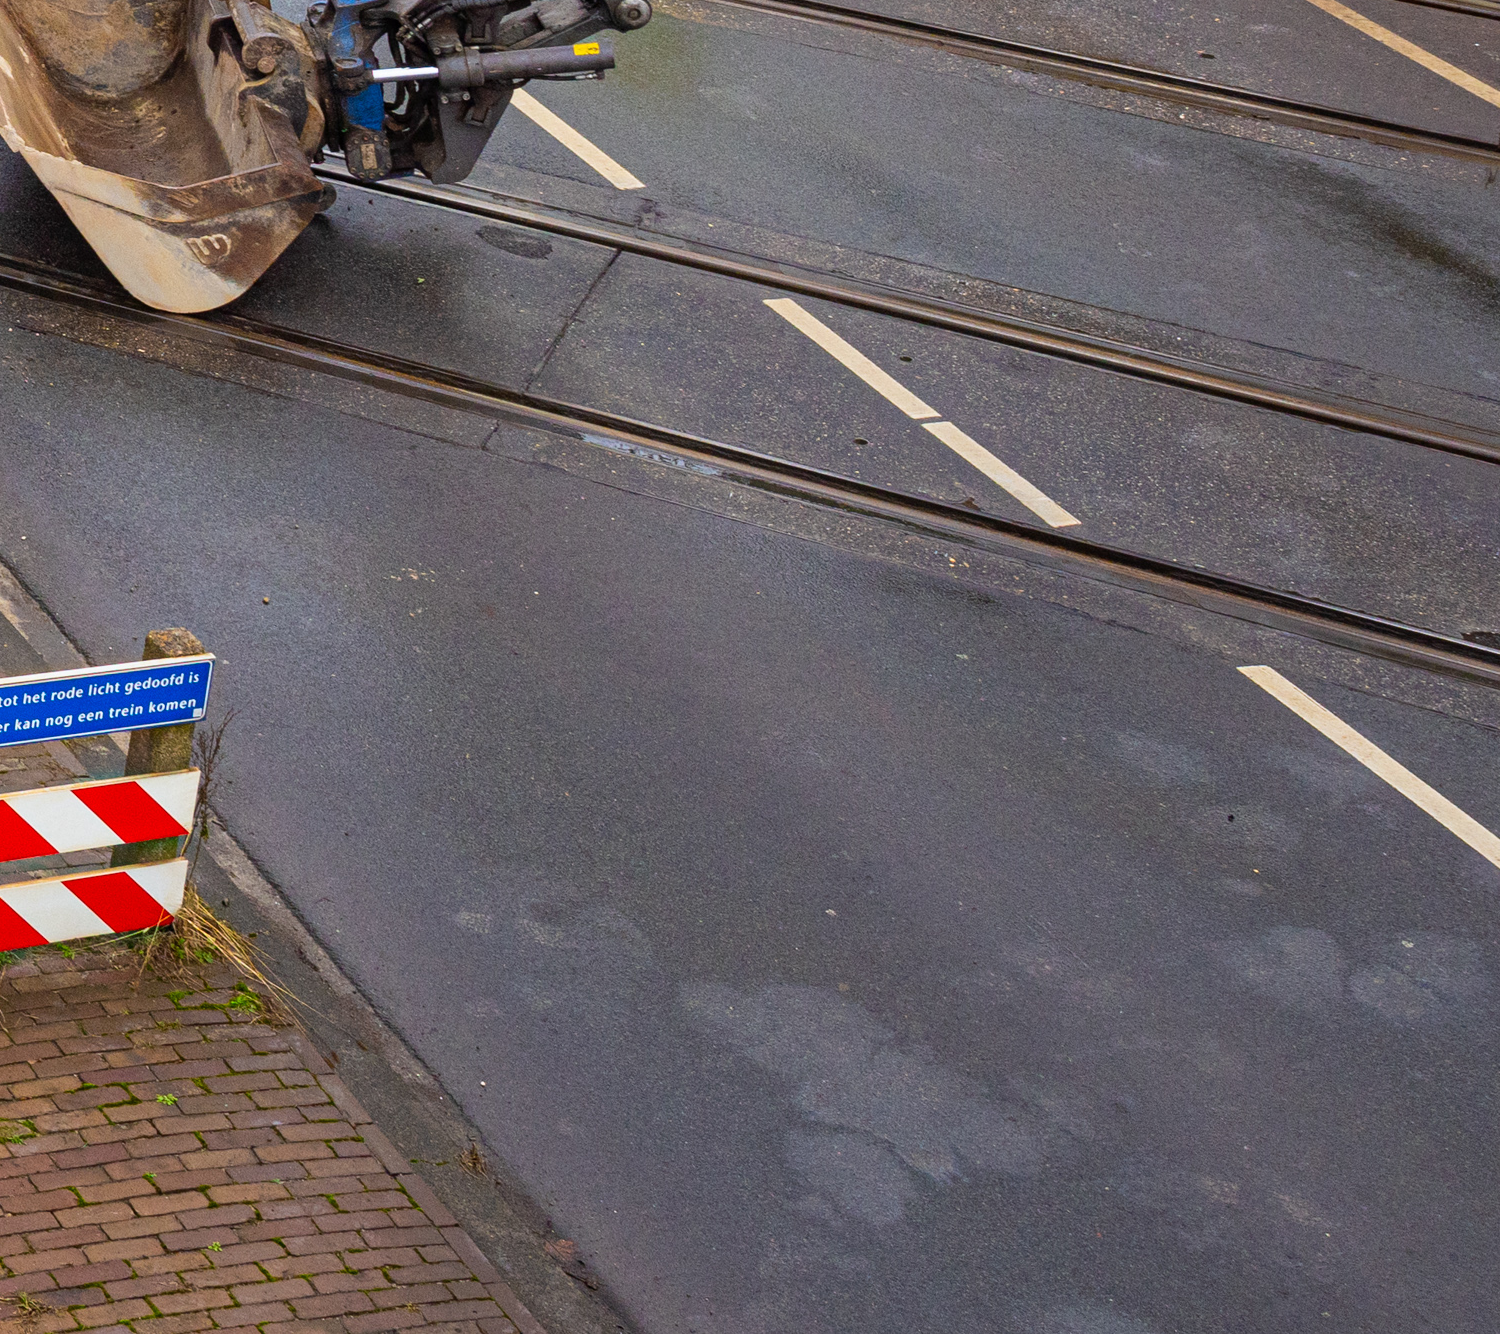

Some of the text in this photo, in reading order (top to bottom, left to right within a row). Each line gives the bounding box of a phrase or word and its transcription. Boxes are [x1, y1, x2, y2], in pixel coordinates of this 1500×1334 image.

[22, 691, 47, 705] het
[50, 686, 84, 702] rode
[87, 680, 121, 697] licht
[123, 672, 185, 695] gedoofd
[188, 670, 200, 684] is
[13, 717, 41, 731] kan
[44, 714, 73, 729] nog
[77, 709, 104, 723] een
[108, 703, 144, 719] trein
[148, 696, 197, 715] komen
